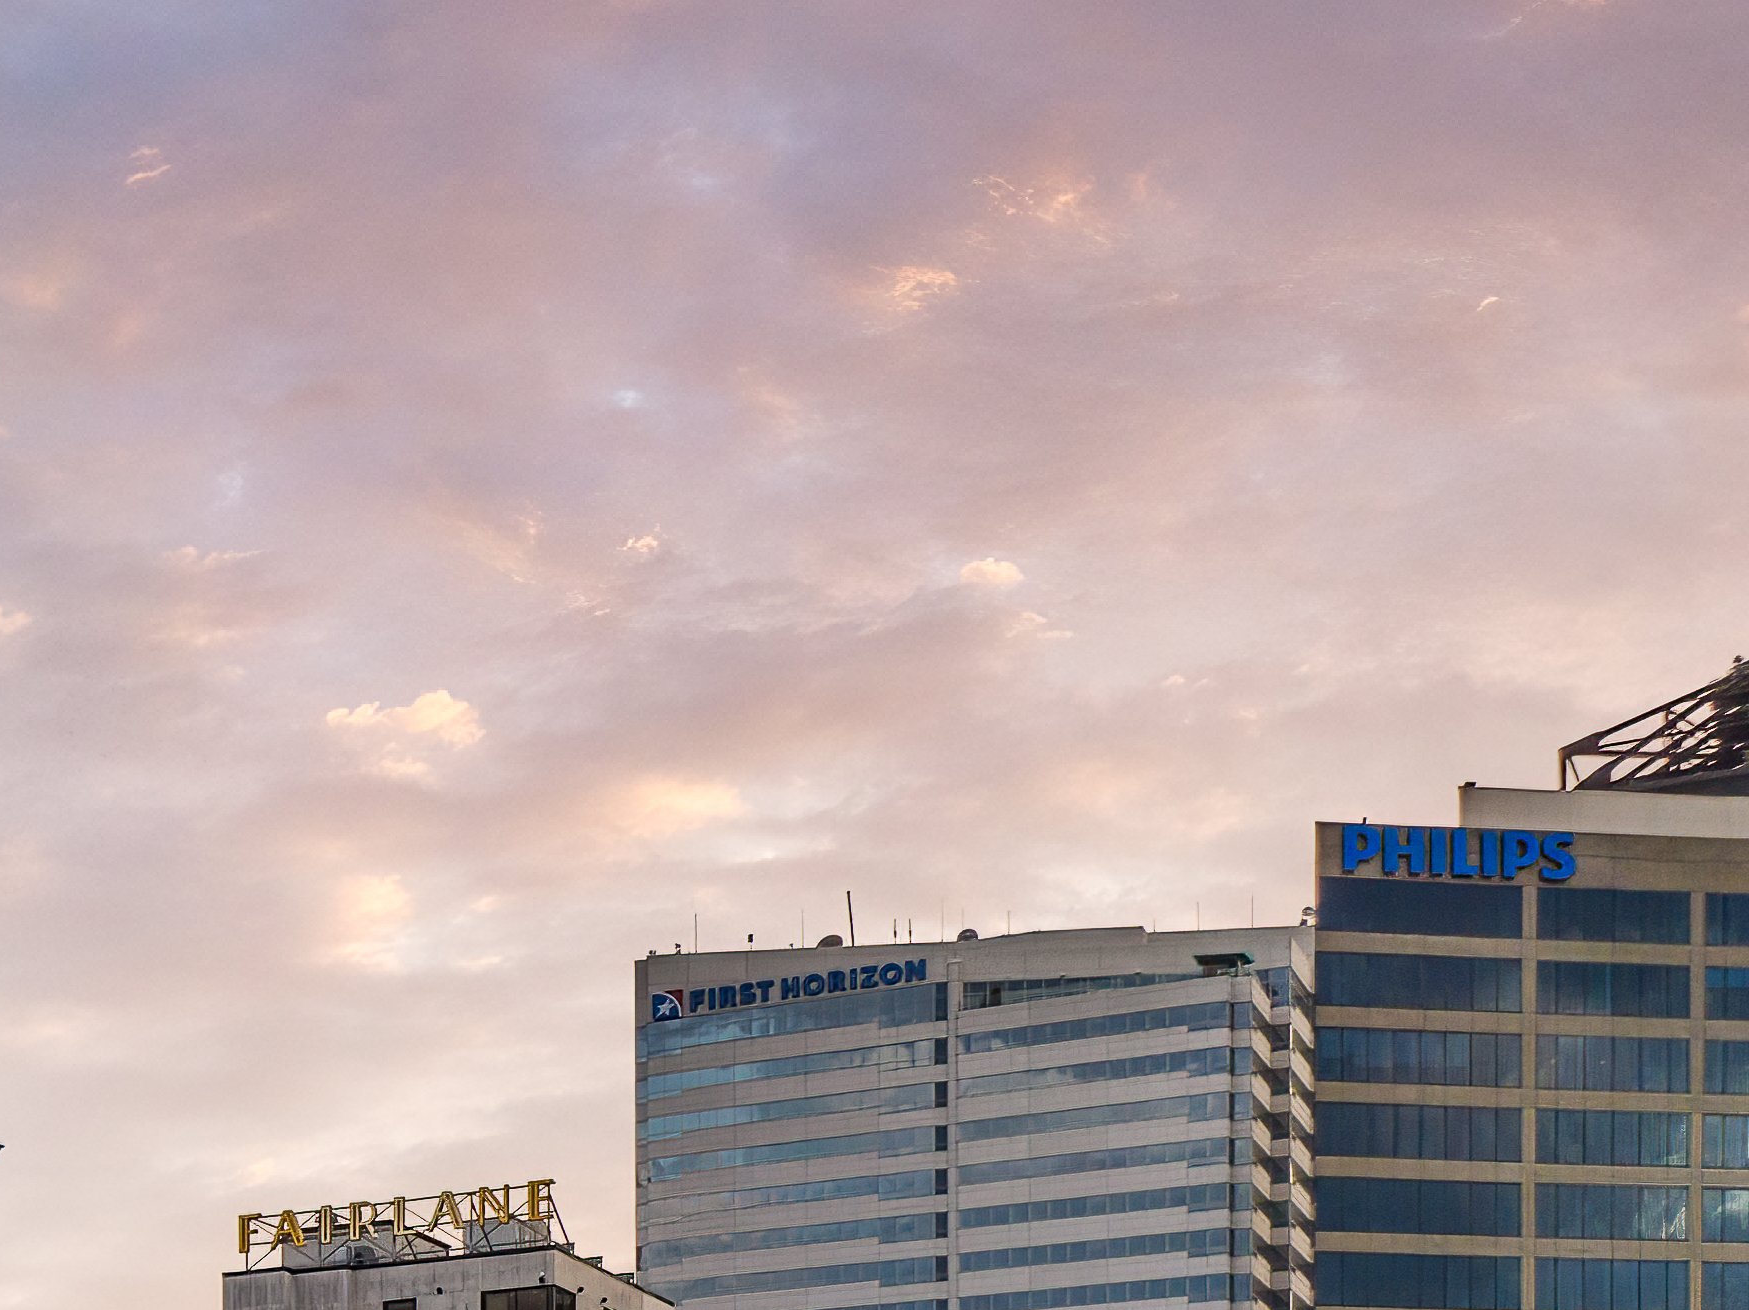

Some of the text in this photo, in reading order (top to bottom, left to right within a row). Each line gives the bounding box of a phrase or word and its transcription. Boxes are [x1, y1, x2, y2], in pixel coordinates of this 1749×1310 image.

[1342, 823, 1577, 881] PHILIPS
[690, 958, 927, 1014] FIRST HORIZON
[238, 1178, 556, 1254] FAIRLANE
